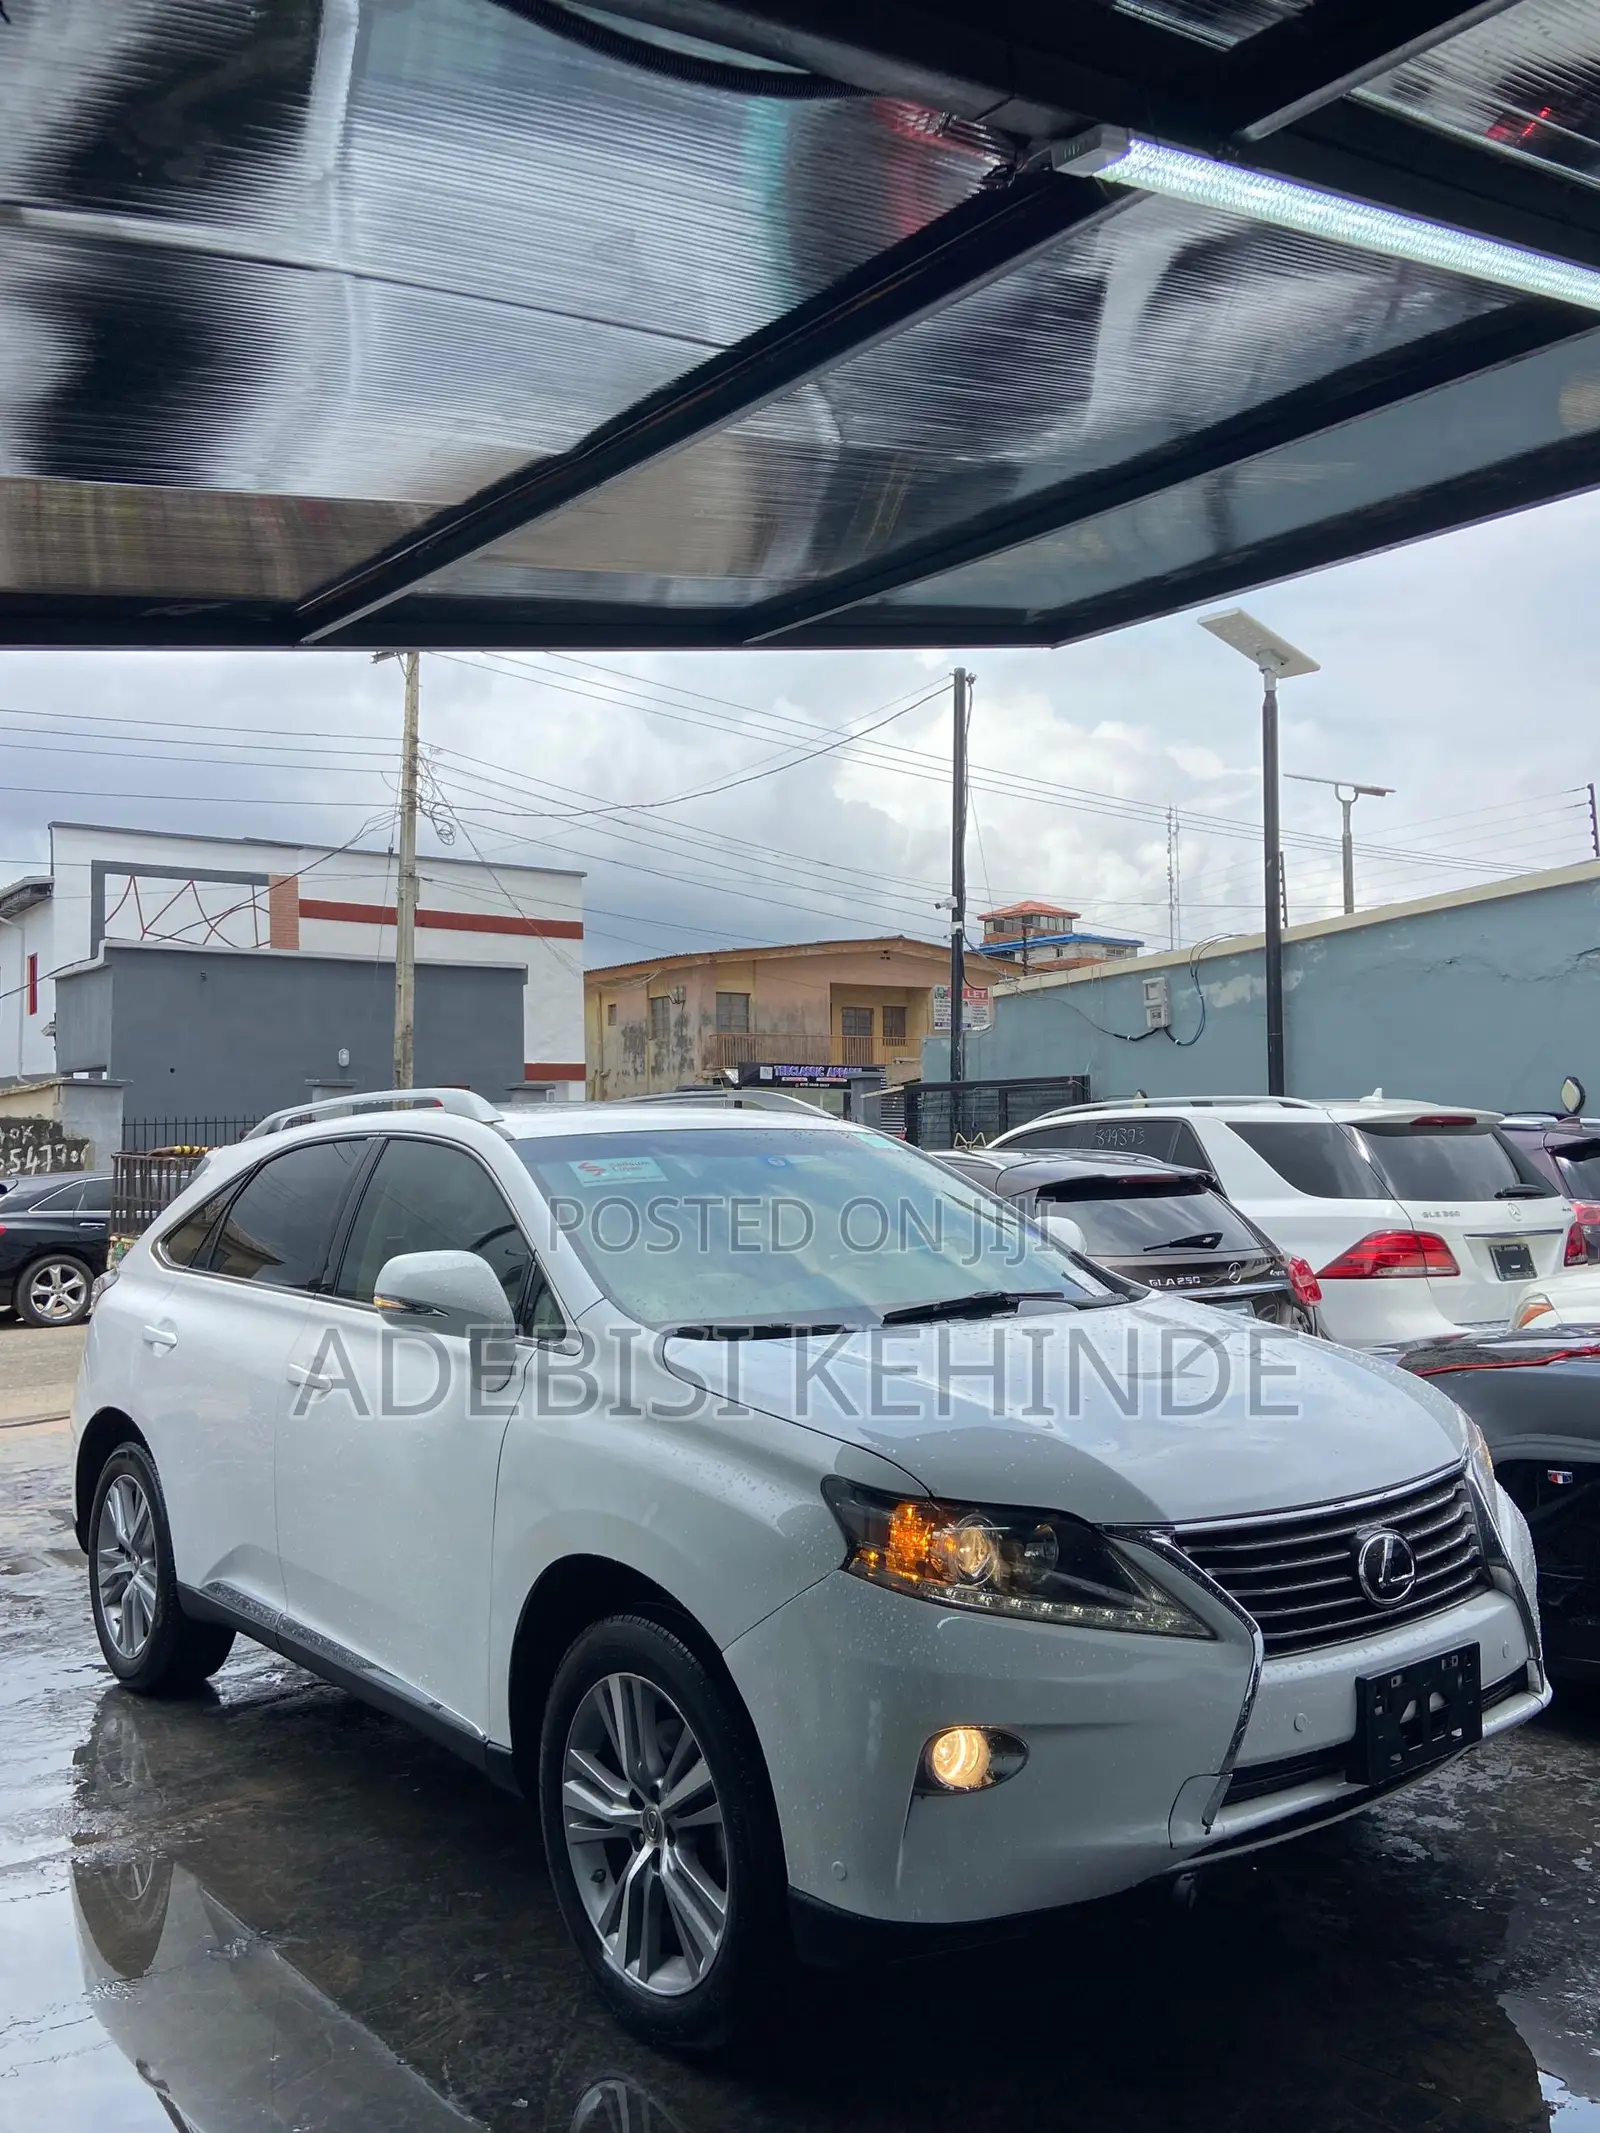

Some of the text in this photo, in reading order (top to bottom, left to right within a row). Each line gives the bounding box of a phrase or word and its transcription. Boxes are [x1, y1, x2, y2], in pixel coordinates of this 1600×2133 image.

[967, 990, 986, 999] LET
[1148, 1275, 1201, 1287] GLA 250
